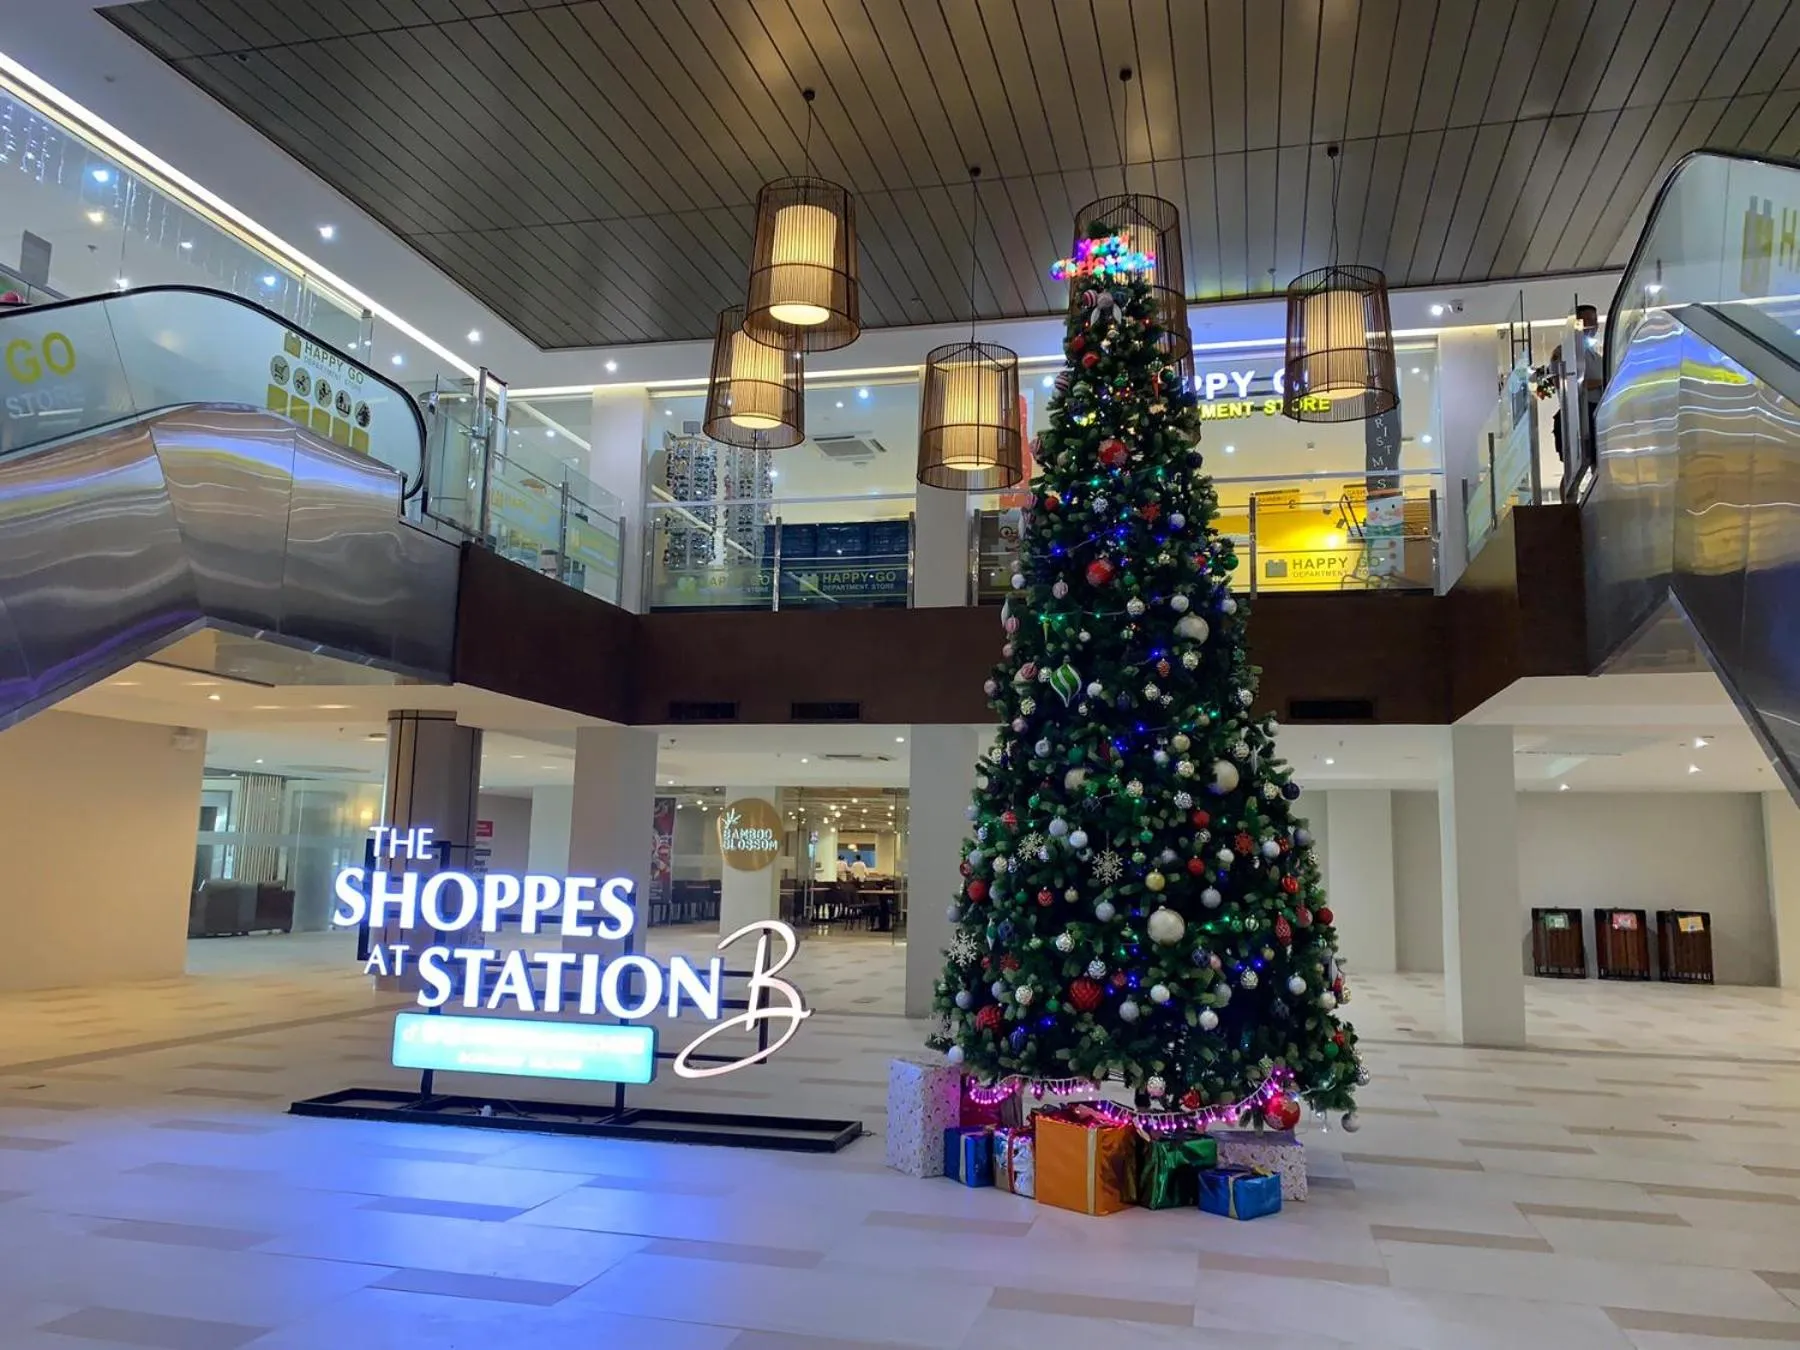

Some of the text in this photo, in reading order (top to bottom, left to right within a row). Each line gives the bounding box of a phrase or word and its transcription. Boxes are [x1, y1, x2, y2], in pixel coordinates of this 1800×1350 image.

[5, 332, 76, 384] GO
[305, 341, 365, 385] HAPPY GO
[1201, 402, 1254, 420] MENT
[1293, 557, 1348, 570] HAPPY
[823, 571, 896, 583] HAPPY GO
[823, 583, 868, 591] DEPARTMENT
[369, 826, 434, 859] THE
[724, 828, 773, 840] BAMBOO
[723, 839, 778, 850] BLOSSOM
[333, 867, 635, 940] SHOPPES
[364, 944, 410, 976] AT
[417, 946, 725, 1019] STATION
[673, 920, 814, 1079] B
